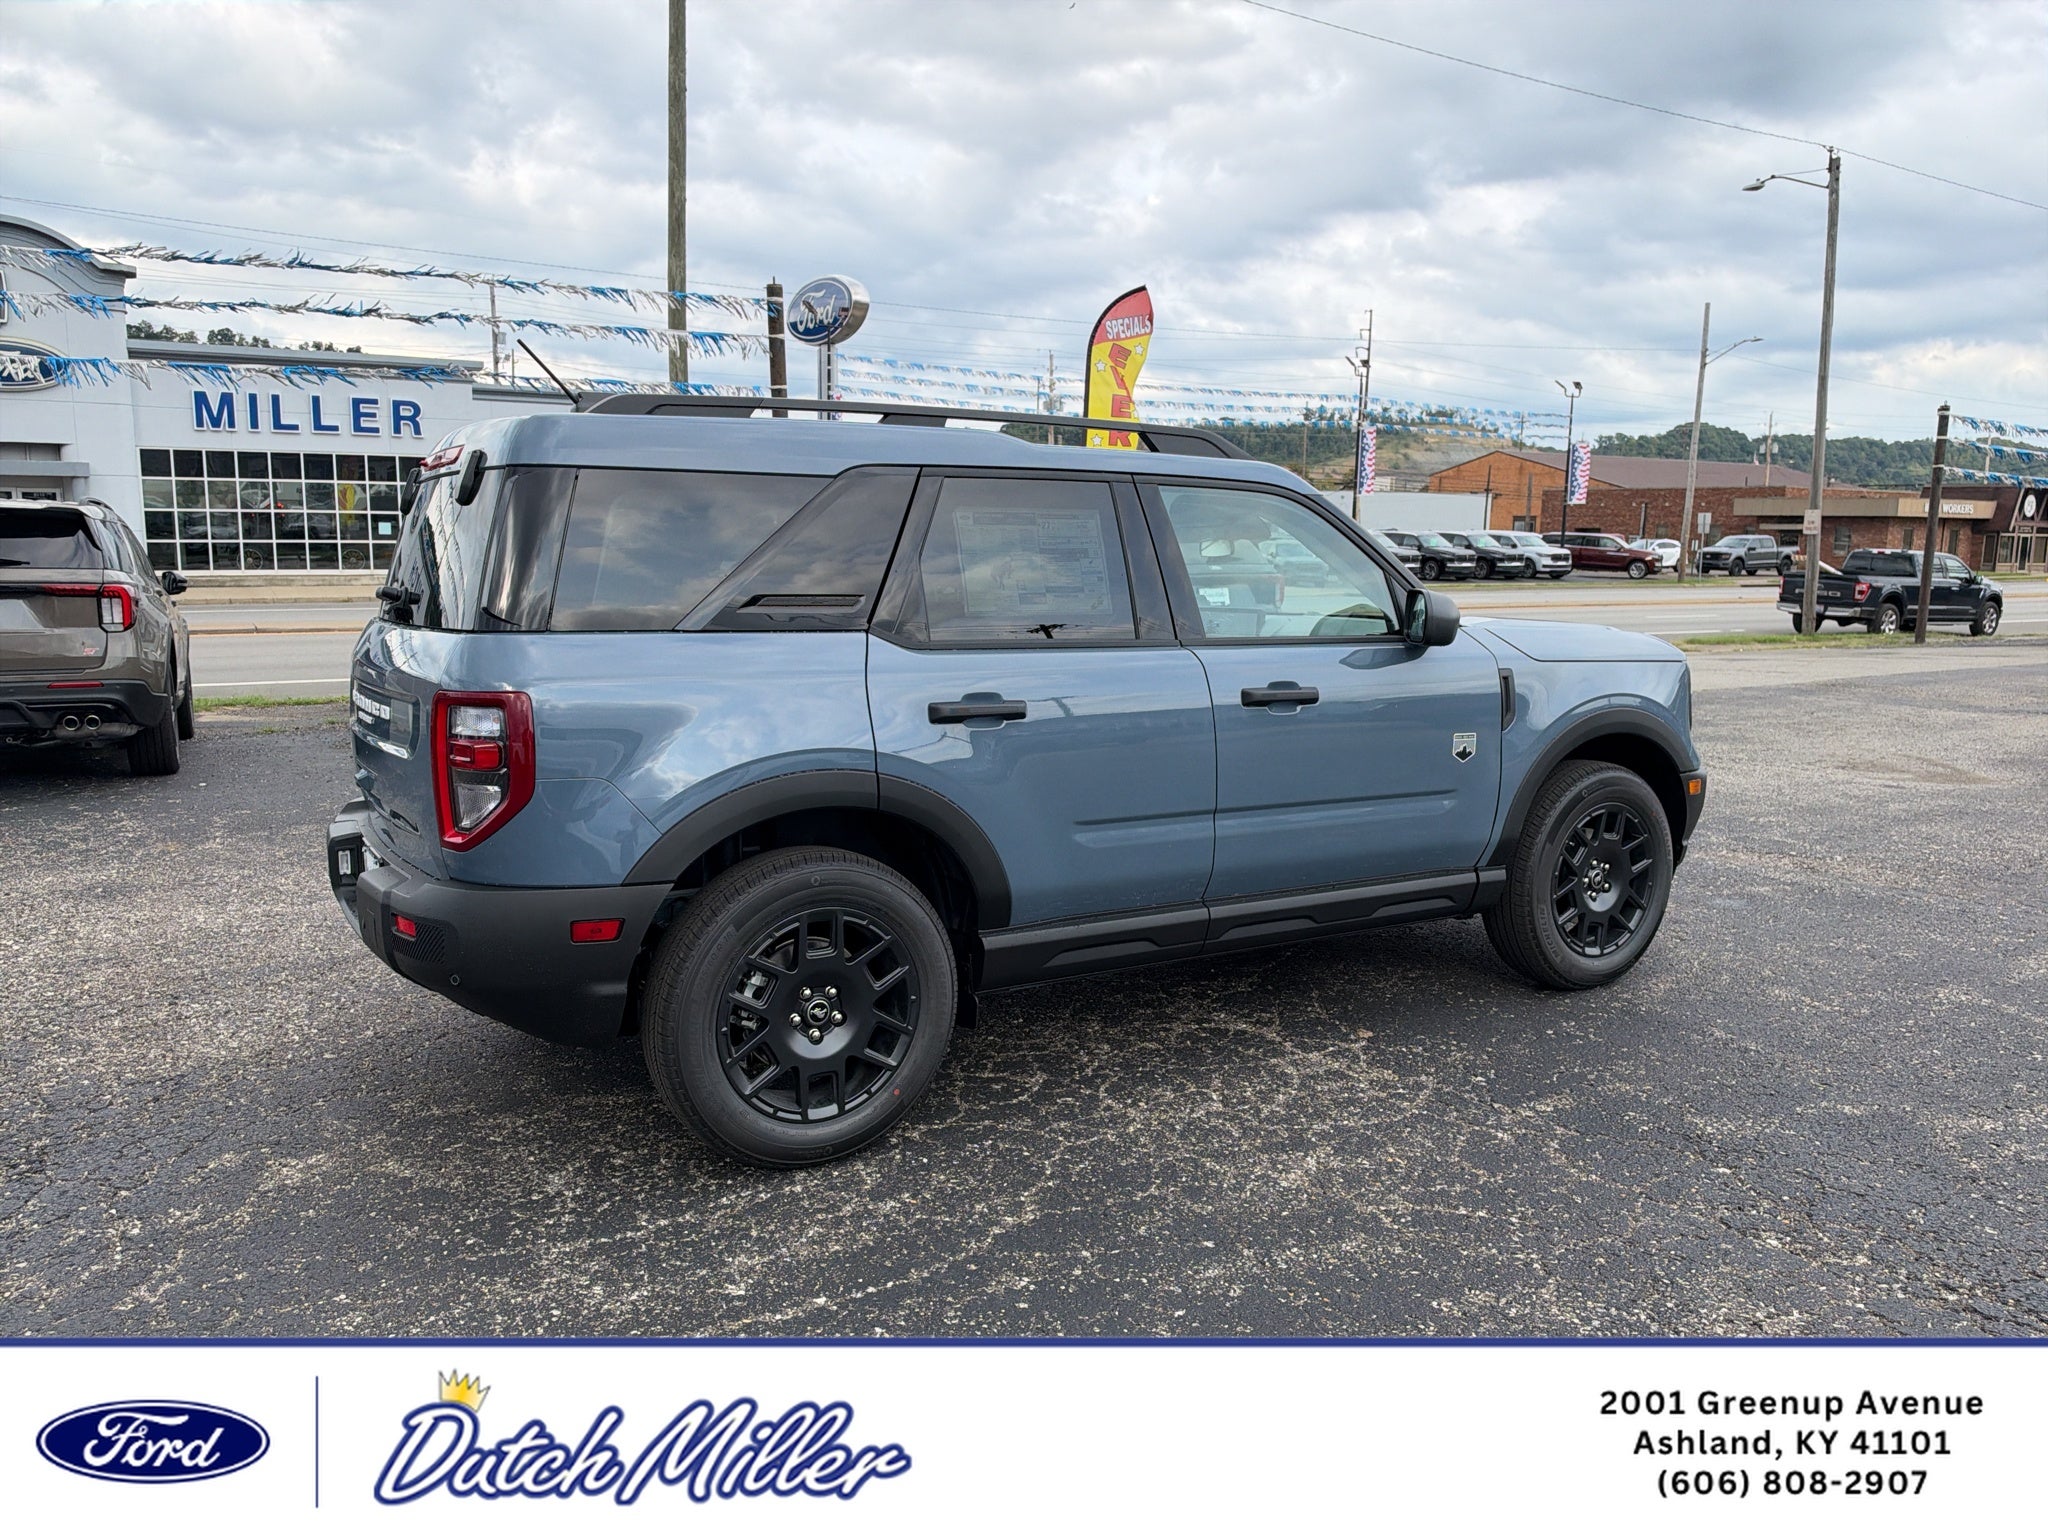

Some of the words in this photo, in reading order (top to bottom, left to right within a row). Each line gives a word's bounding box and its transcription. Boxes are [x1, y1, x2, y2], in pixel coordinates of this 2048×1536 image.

[797, 289, 836, 333] Ford
[1105, 314, 1151, 340] SPECIALS
[192, 389, 424, 438] MILLER
[1942, 503, 1974, 514] WORKERS
